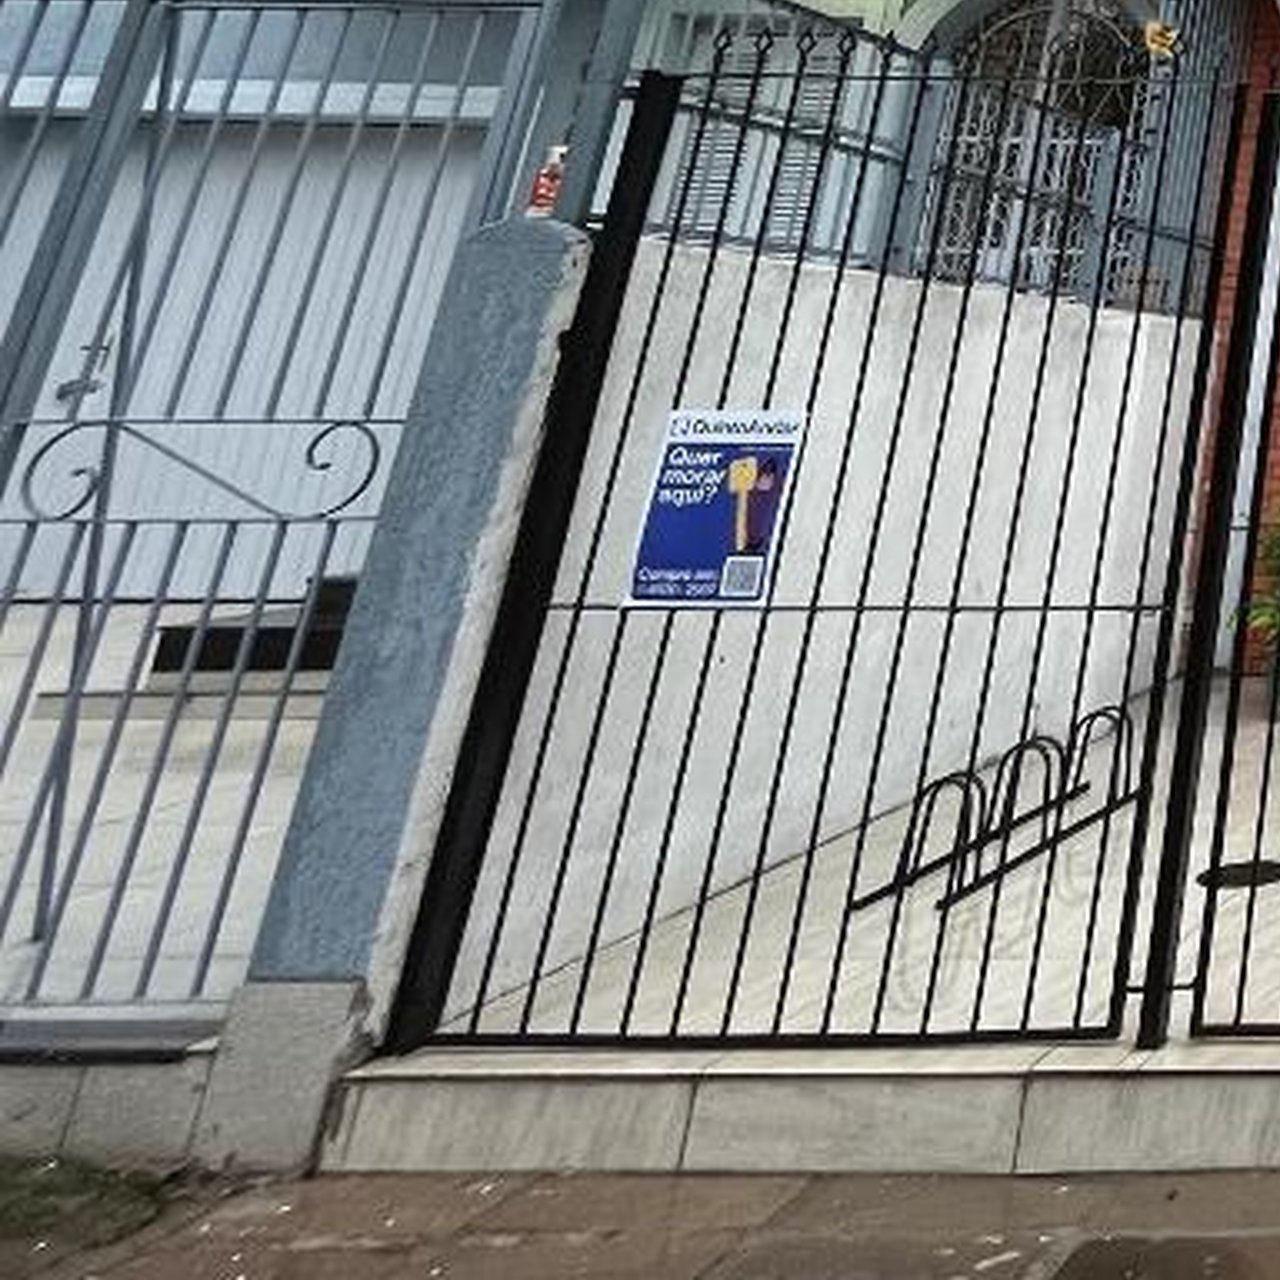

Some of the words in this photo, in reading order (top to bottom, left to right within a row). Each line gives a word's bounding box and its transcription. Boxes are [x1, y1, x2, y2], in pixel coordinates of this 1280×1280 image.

[669, 447, 722, 465] Quer
[662, 469, 727, 484] morar
[658, 484, 718, 507] aqui?
